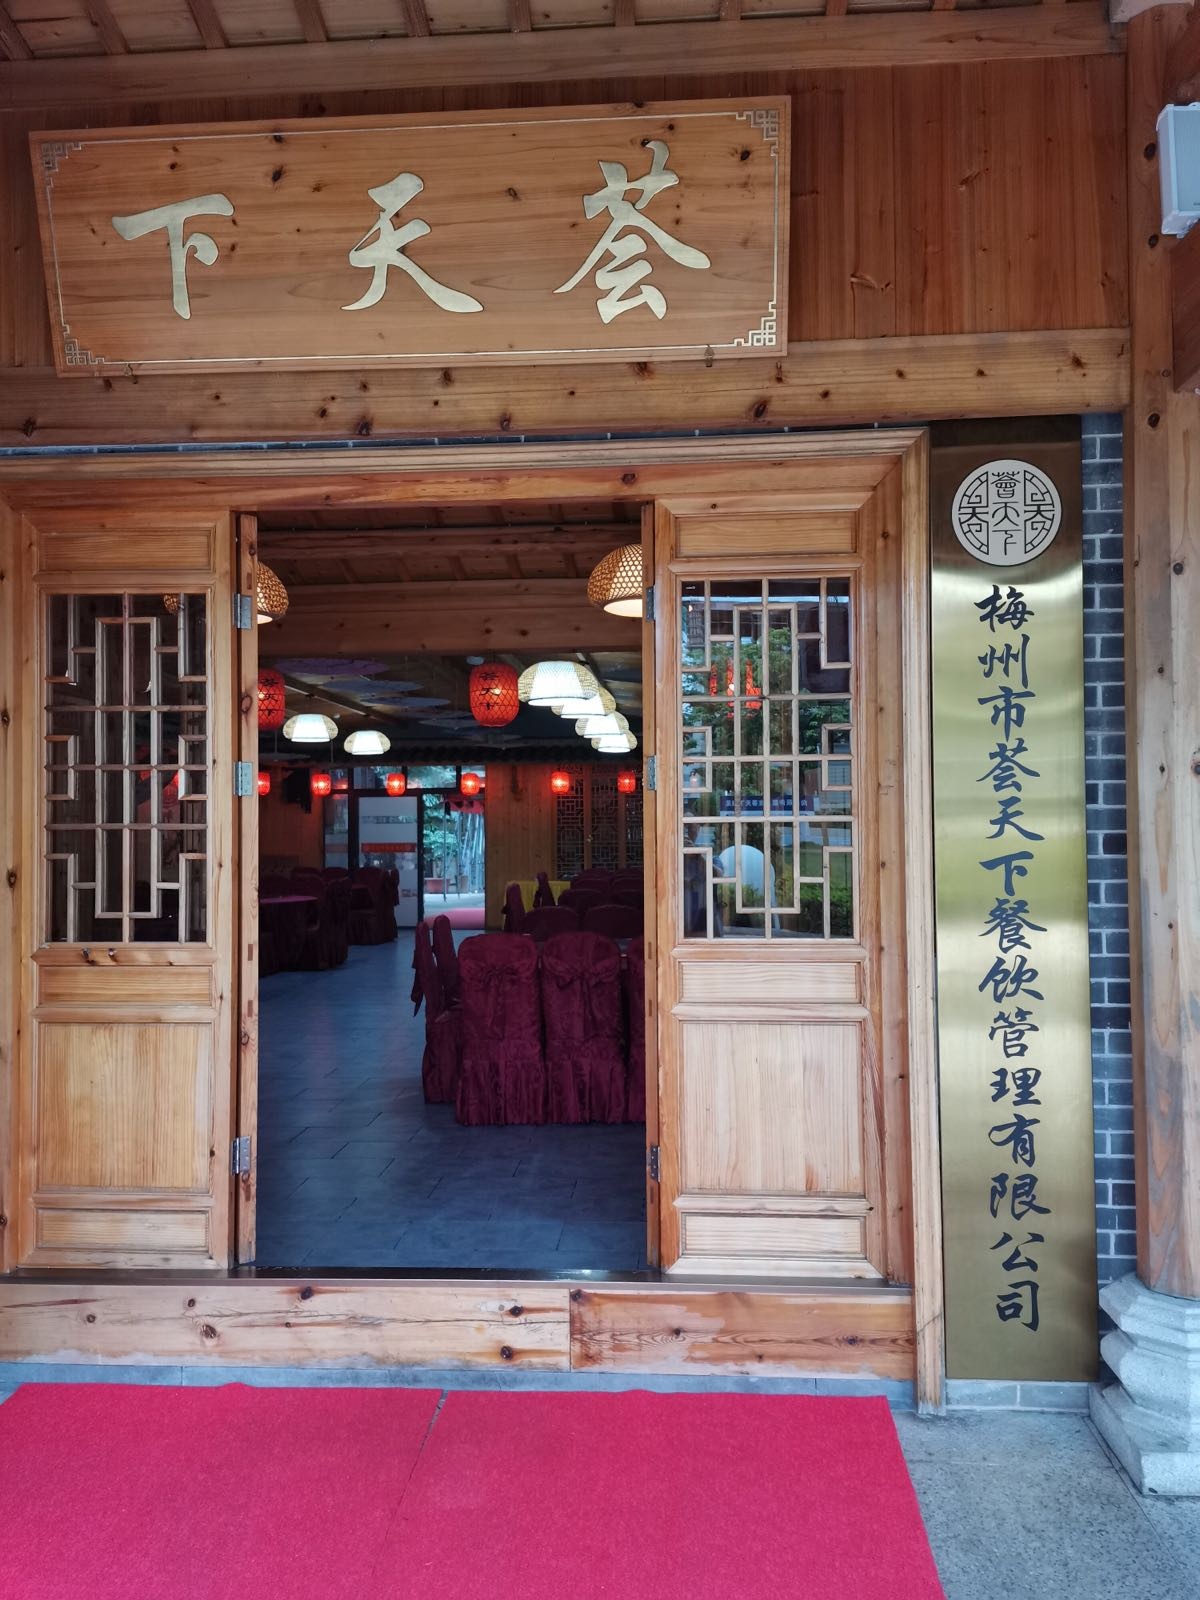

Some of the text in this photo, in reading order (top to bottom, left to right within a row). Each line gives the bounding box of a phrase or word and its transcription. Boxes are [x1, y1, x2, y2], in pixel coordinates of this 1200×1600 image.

[113, 140, 711, 324] 荟天下
[974, 584, 1051, 1332] 梅州市荟天下餐饮管理有限公司
